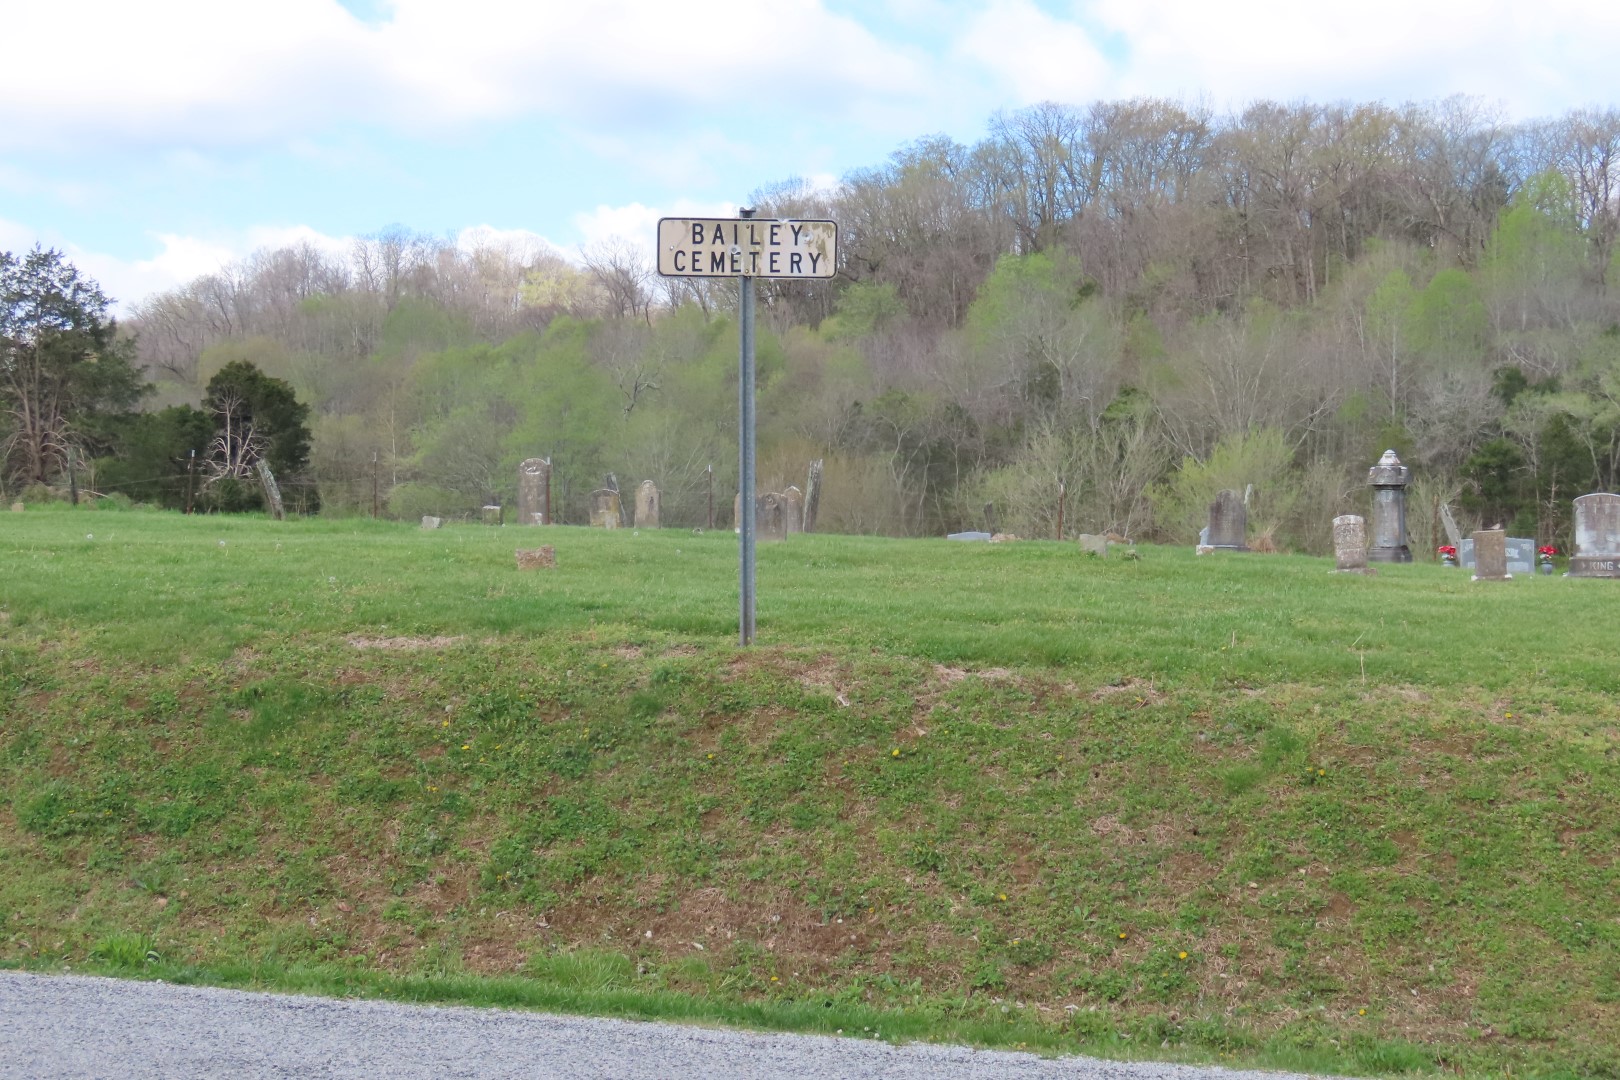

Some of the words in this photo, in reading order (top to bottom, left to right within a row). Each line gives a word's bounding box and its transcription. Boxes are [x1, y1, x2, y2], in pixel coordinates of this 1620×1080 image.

[692, 223, 802, 246] BAILEY
[674, 251, 822, 274] CEMETERY
[1590, 561, 1614, 571] KING
